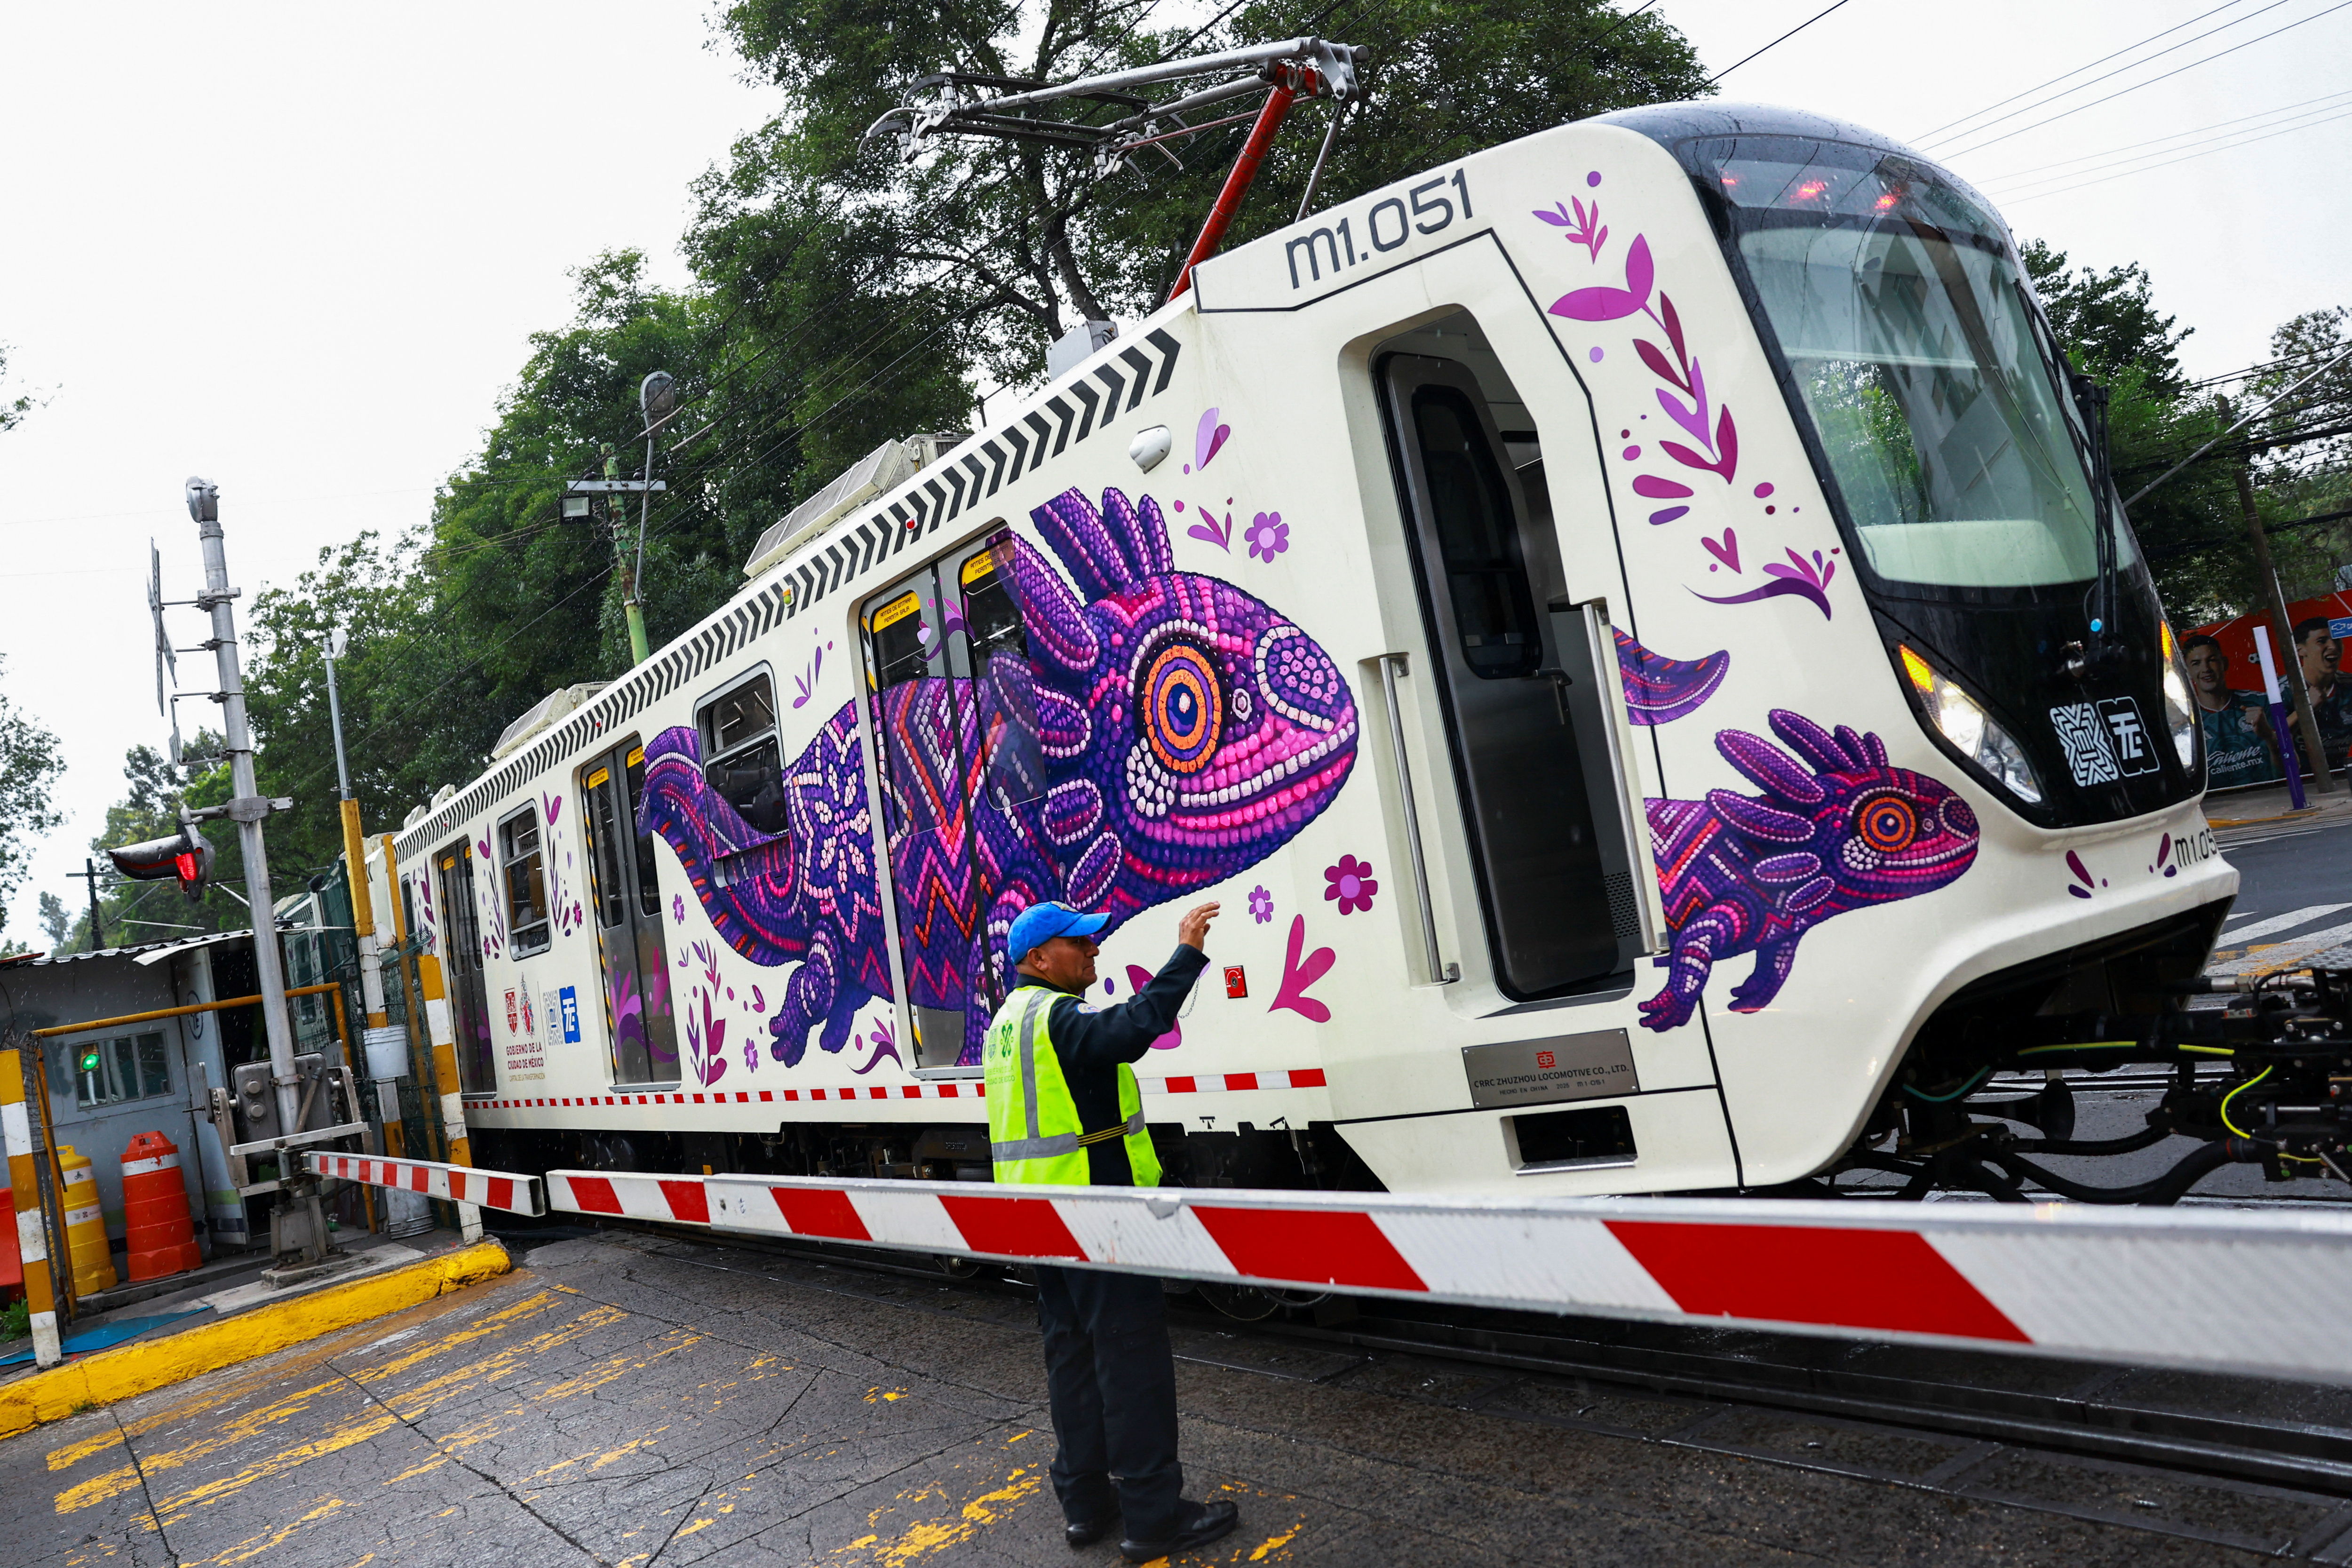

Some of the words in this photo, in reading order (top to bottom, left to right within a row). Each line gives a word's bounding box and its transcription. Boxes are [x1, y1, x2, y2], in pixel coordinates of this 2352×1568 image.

[970, 558, 984, 569] ANTES
[975, 562, 992, 575] PERMITA
[880, 608, 892, 618] ANTES
[898, 597, 912, 608] ENTRAR
[884, 612, 898, 623] PERMITA
[2210, 757, 2263, 774] caliente.mx
[506, 1043, 528, 1056] GOBIERNO
[529, 1043, 535, 1053] DE
[536, 1042, 542, 1052] LA
[508, 1059, 522, 1070] CIUDAD
[522, 1059, 528, 1068] DE
[528, 1055, 544, 1068] MÉXICO
[1474, 1079, 1495, 1088] CRRC
[1496, 1075, 1536, 1085] ZHUZHOU
[1538, 1068, 1591, 1081] LOCOMOTIVE
